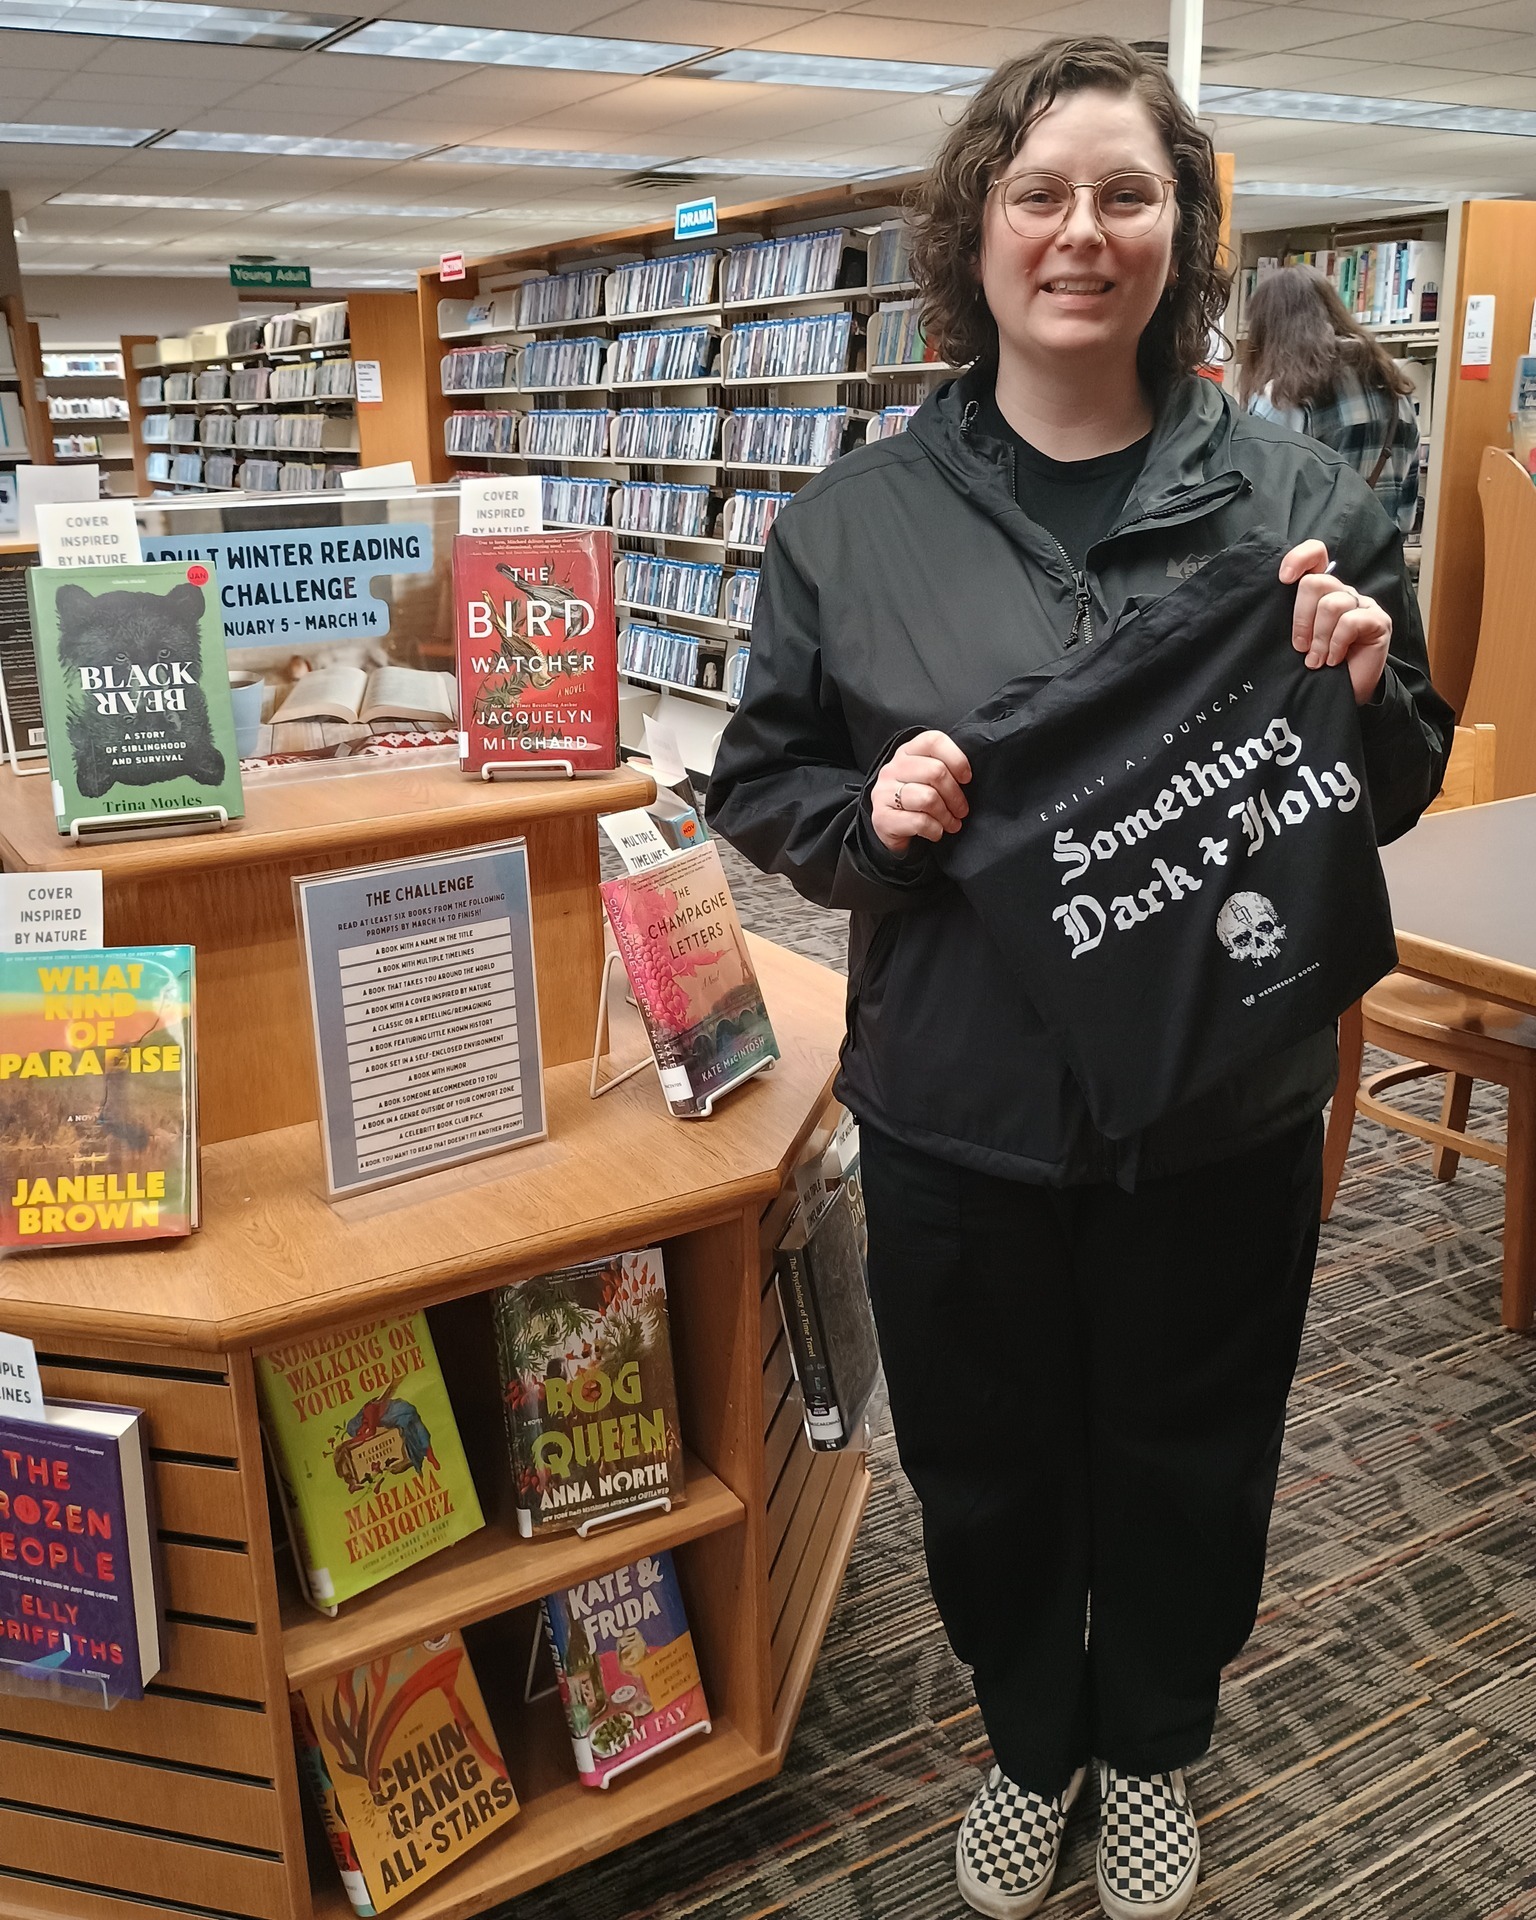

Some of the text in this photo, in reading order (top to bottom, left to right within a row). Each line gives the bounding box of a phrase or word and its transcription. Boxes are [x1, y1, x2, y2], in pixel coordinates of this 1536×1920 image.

[680, 208, 713, 228] DRAMA
[234, 269, 307, 283] Young Adult
[483, 491, 519, 501] COVER
[66, 516, 109, 528] COVER
[477, 508, 526, 519] INSPIRED
[61, 534, 119, 547] INSPIRED
[227, 542, 313, 570] WINTER
[320, 535, 421, 565] READING
[59, 553, 128, 566] BY NATURE
[510, 567, 549, 582] THE
[189, 572, 206, 580] JAN
[221, 577, 358, 608] CHALLENGE
[224, 619, 279, 638] NUARY
[281, 617, 289, 633] 5
[305, 612, 358, 631] MARCH
[361, 611, 378, 627] 14
[467, 600, 596, 639] BIRD
[78, 661, 197, 691] BLACK
[471, 655, 595, 674] WATCHER
[557, 683, 586, 698] A NOVEL
[476, 710, 592, 725] JACQUELYN
[105, 741, 187, 754] OF SIBLINGHOOD
[124, 729, 166, 741] A STORY
[484, 736, 587, 751] MITCHARD
[112, 753, 184, 766] AND SURVIVAL
[1040, 681, 1254, 822] EMILY A. DUNCAN
[102, 798, 146, 814] Trina
[1052, 717, 1303, 886] Something
[621, 830, 657, 849] MULTIPLE
[683, 823, 695, 834] NOV
[1052, 857, 1203, 960] Dark
[1227, 761, 1361, 857] Holy
[28, 887, 73, 900] COVER
[366, 875, 474, 907] THE CHALLENGE
[673, 886, 691, 901] THE
[20, 908, 82, 922] INSPIRED
[338, 893, 505, 930] READ AT LEAST SIX BOOKS FROM THE FOLLOWING
[366, 908, 483, 937] PROMPTS BY MARCH 14 TO FINISH!
[648, 891, 728, 940] CHAMPAGNE
[15, 929, 87, 945] BY NATURE
[381, 945, 399, 955] BOOK
[400, 942, 414, 951] WITH
[421, 937, 438, 946] NAME
[458, 930, 474, 939] TITLE
[669, 922, 724, 960] LETTERS
[382, 963, 400, 973] BOOK
[401, 959, 416, 968] WITH
[417, 954, 444, 966] MULTIPLE
[445, 948, 475, 960] TIMELINES
[609, 898, 653, 1018] CHAMPAGNE LETTERS
[38, 964, 144, 993] WHAT
[368, 986, 386, 995] BOOK
[387, 982, 403, 991] THAT
[403, 978, 424, 987] TAKES
[425, 974, 437, 983] YOU
[438, 969, 463, 980] AROUND
[463, 967, 474, 975] THE
[475, 962, 495, 972] WORLD
[1257, 975, 1297, 998] WEDNESDAY
[1297, 961, 1321, 978] BOOKS
[44, 993, 137, 1021] KIND
[371, 1004, 389, 1014] BOOK
[390, 1001, 404, 1009] WITH
[411, 995, 431, 1005] COVER
[432, 989, 459, 1001] INSPIRED
[469, 982, 492, 992] NATURE
[378, 1020, 403, 1031] CLASSIC
[420, 1000, 492, 1022] RETELLING/REIMAGINING
[68, 1021, 115, 1048] OF
[0, 1046, 181, 1080] PARADISE
[663, 1043, 677, 1068] KATE
[701, 1064, 723, 1082] KATE
[12, 1171, 165, 1207] JANELLE
[18, 1200, 159, 1235] BROWN
[789, 1256, 816, 1358] The Psychology of Time Travel
[285, 1320, 417, 1395] WALKING ON
[292, 1345, 426, 1423] YOUR GRAVE
[544, 1361, 642, 1417] BOG
[531, 1408, 667, 1479] QUEEN
[2, 1449, 71, 1490] THE
[599, 1462, 668, 1497] NORTH
[344, 1469, 441, 1534] MARIANA
[344, 1489, 455, 1564] ENRIQUEZ
[0, 1532, 115, 1582] EOPLE
[568, 1556, 664, 1621] KATE &
[21, 1594, 79, 1626] ELLY
[583, 1590, 661, 1655] FRIDA
[608, 1703, 686, 1757] KIM FAY
[376, 1718, 469, 1803] CHAIN
[387, 1753, 483, 1840] GANG
[380, 1776, 513, 1895] ALL-STARS
